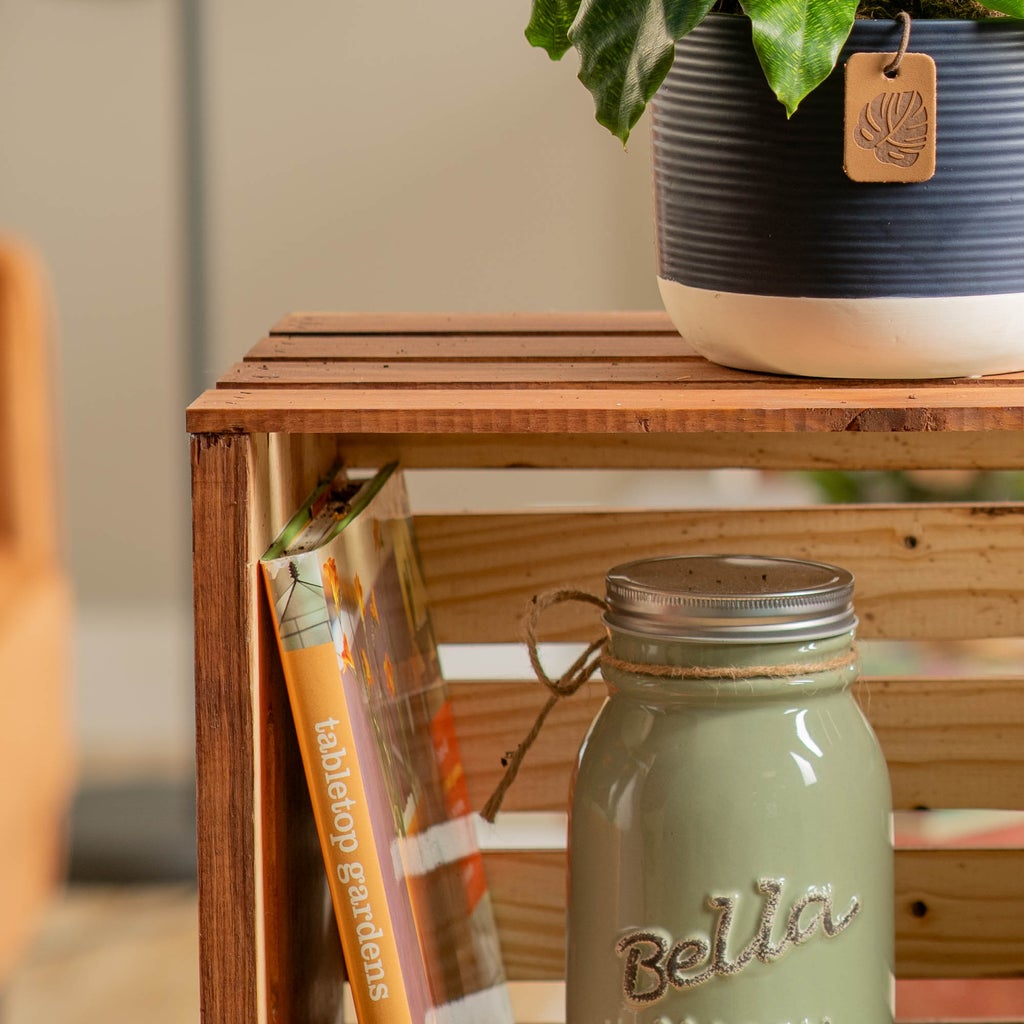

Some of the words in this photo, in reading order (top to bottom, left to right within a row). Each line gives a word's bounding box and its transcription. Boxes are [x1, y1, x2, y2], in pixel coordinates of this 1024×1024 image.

[314, 716, 358, 854] tabletop
[337, 860, 389, 1002] gardens
[615, 876, 862, 1004] Bella
